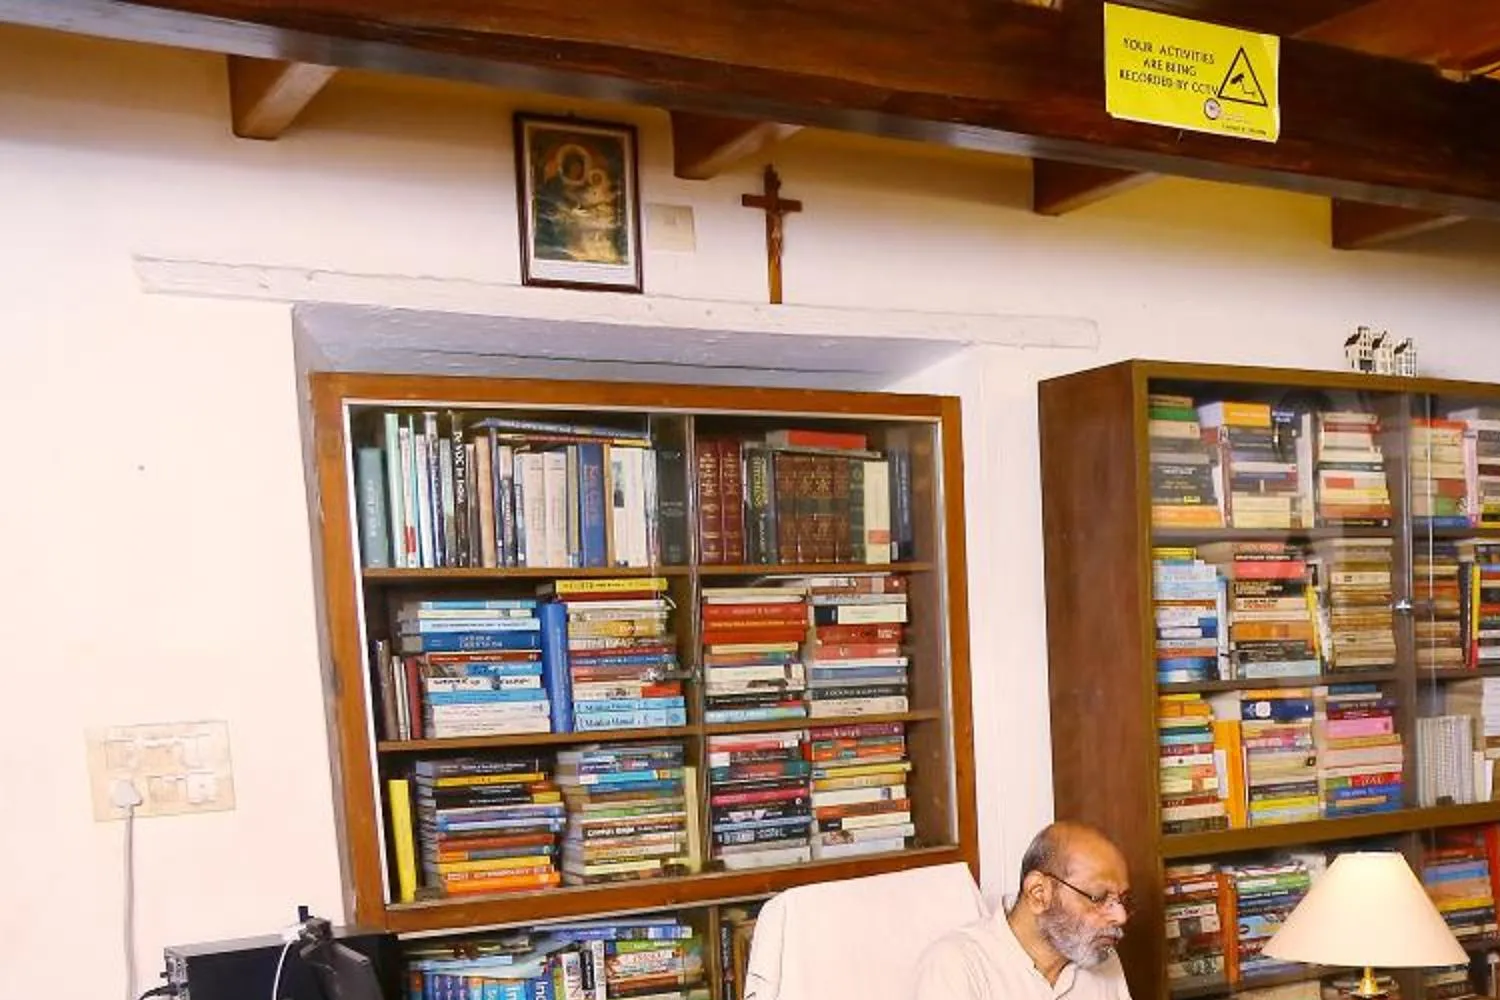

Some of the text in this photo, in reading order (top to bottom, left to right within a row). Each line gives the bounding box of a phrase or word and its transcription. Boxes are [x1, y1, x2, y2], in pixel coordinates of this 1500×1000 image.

[1123, 37, 1215, 64] YOUR ACTIVITIES
[1143, 58, 1197, 76] ARE BEING
[1119, 68, 1219, 95] RECORDED BY CCTV
